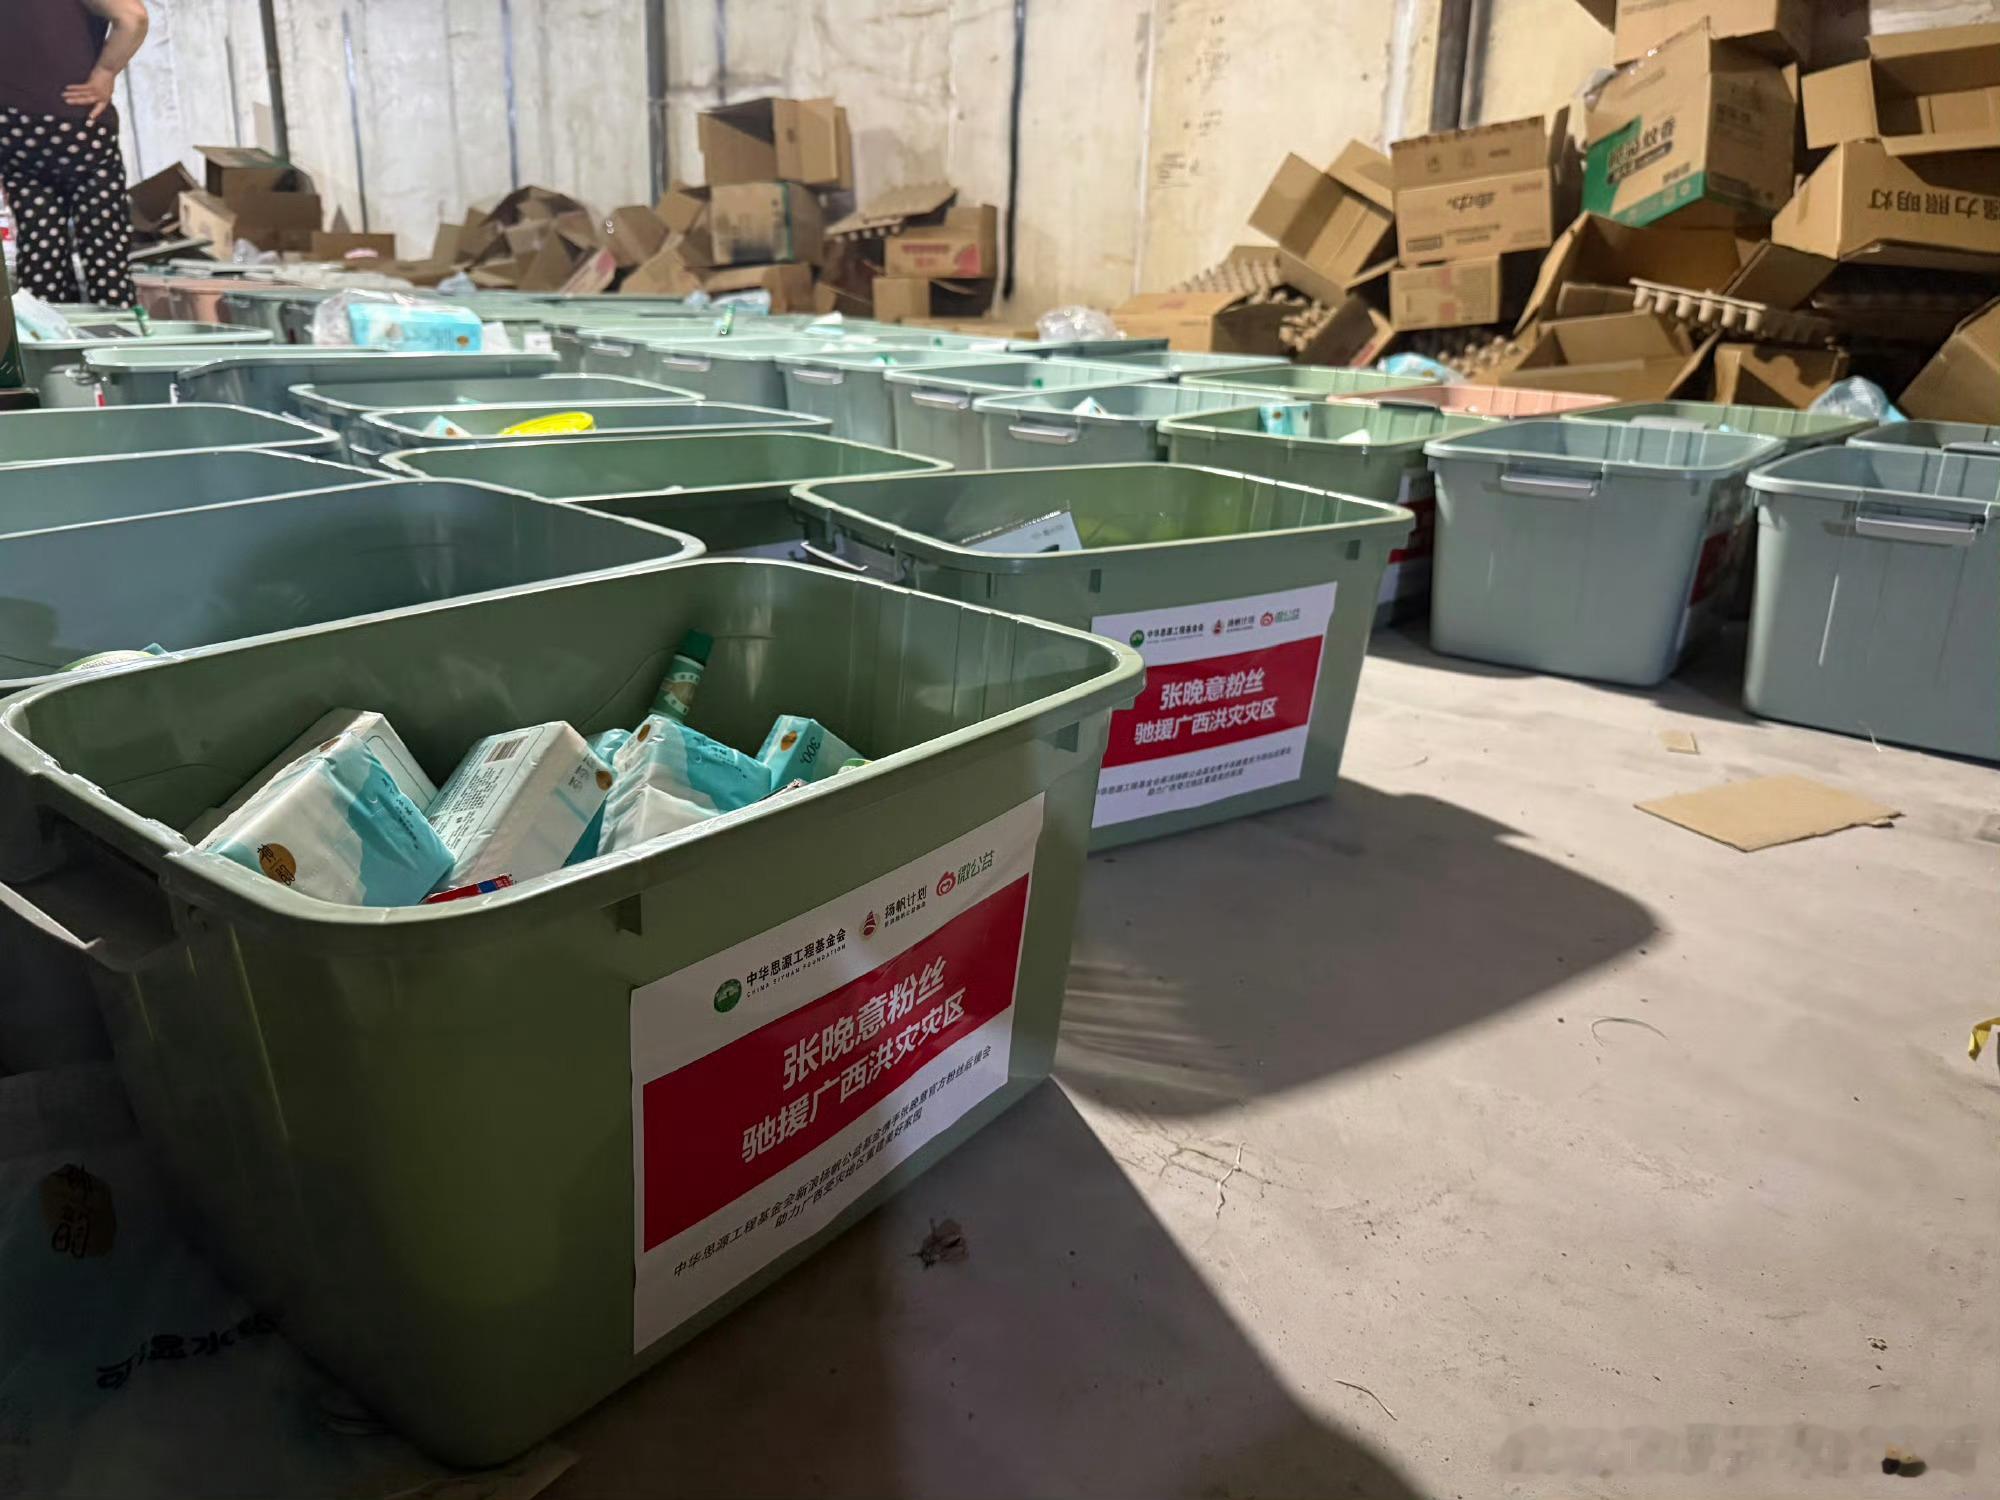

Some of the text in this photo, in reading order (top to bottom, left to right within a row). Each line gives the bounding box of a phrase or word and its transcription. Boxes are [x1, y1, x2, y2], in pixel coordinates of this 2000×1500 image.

[1160, 668, 1264, 710] 张晚意粉丝
[1134, 698, 1277, 744] 驰援广西洪灾灾区
[885, 885, 927, 918] 扬帆计划
[745, 982, 770, 998] CHINA
[802, 943, 847, 971] FOUNDATION
[746, 927, 847, 987] 中华思源工程基金会
[782, 955, 949, 1091] 张晚意粉丝
[741, 987, 967, 1163] 驰援广西洪灾灾区
[774, 1107, 924, 1229] 助力广西受灾地区重建美好家园
